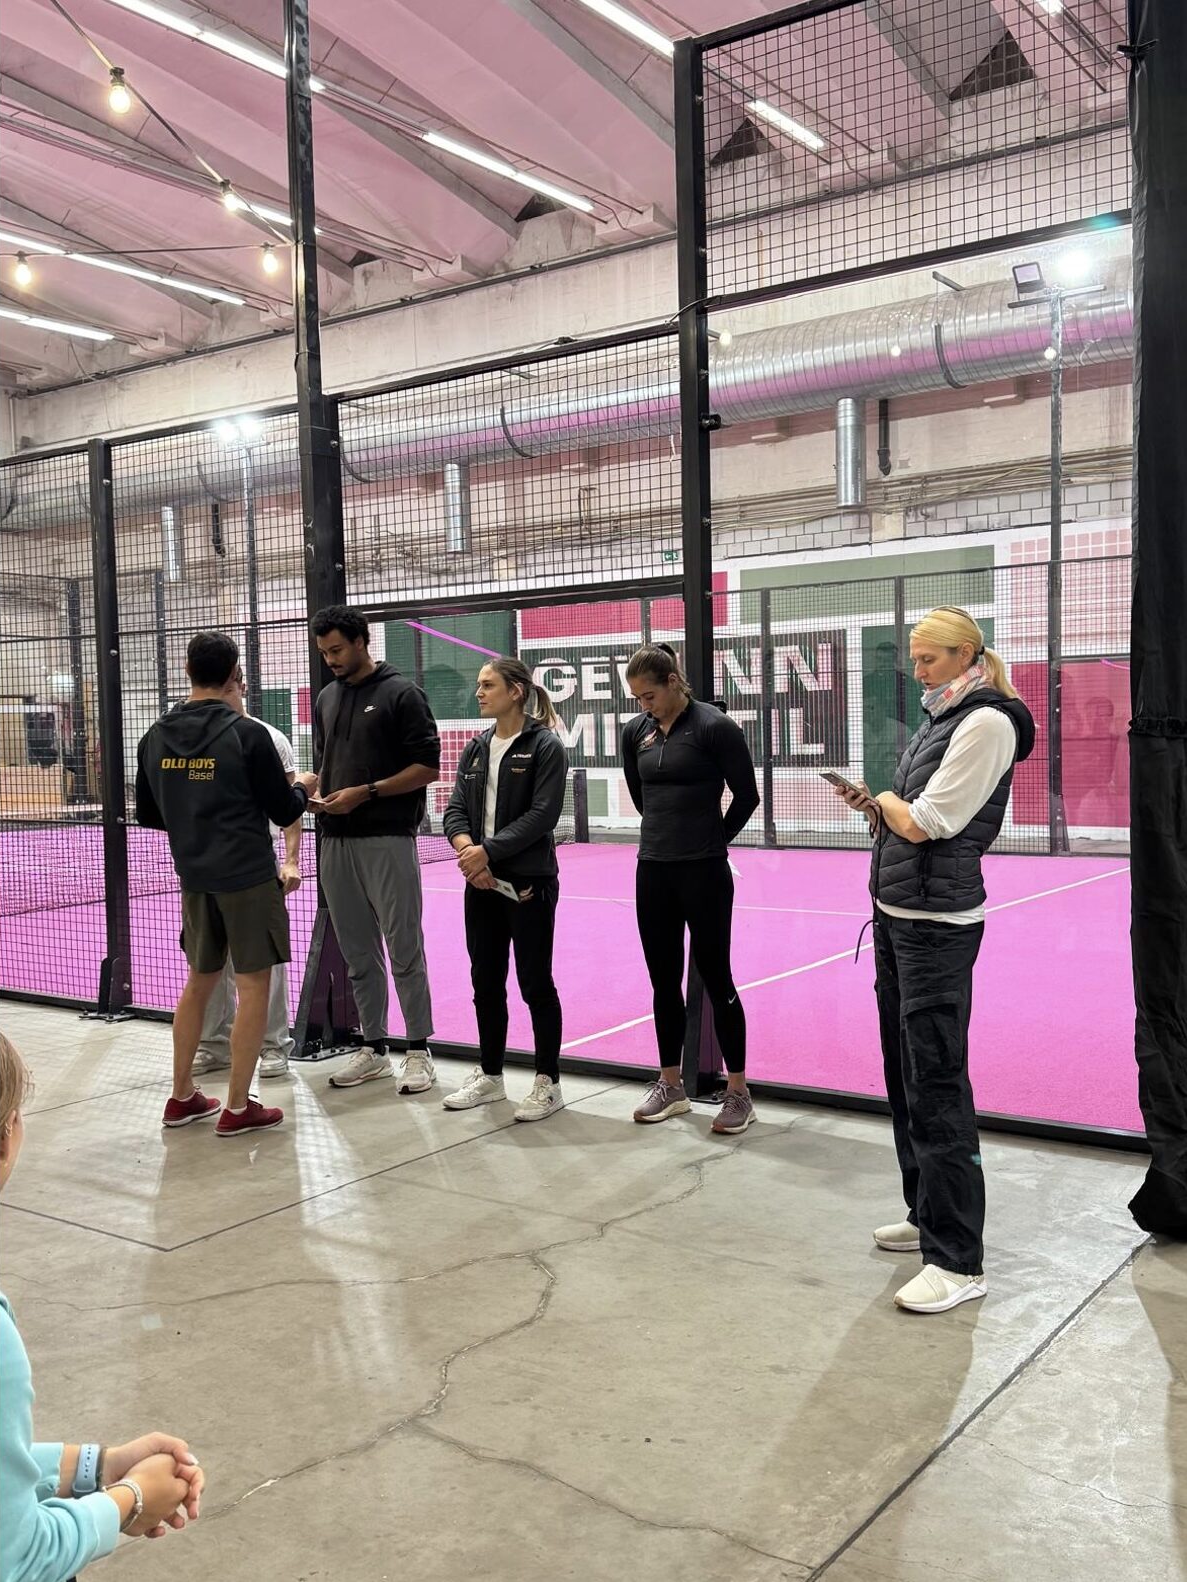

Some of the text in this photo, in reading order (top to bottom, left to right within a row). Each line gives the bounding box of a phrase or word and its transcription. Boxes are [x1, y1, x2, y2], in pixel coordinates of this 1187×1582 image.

[162, 758, 216, 769] OLD BOYS
[188, 769, 215, 781] Basel
